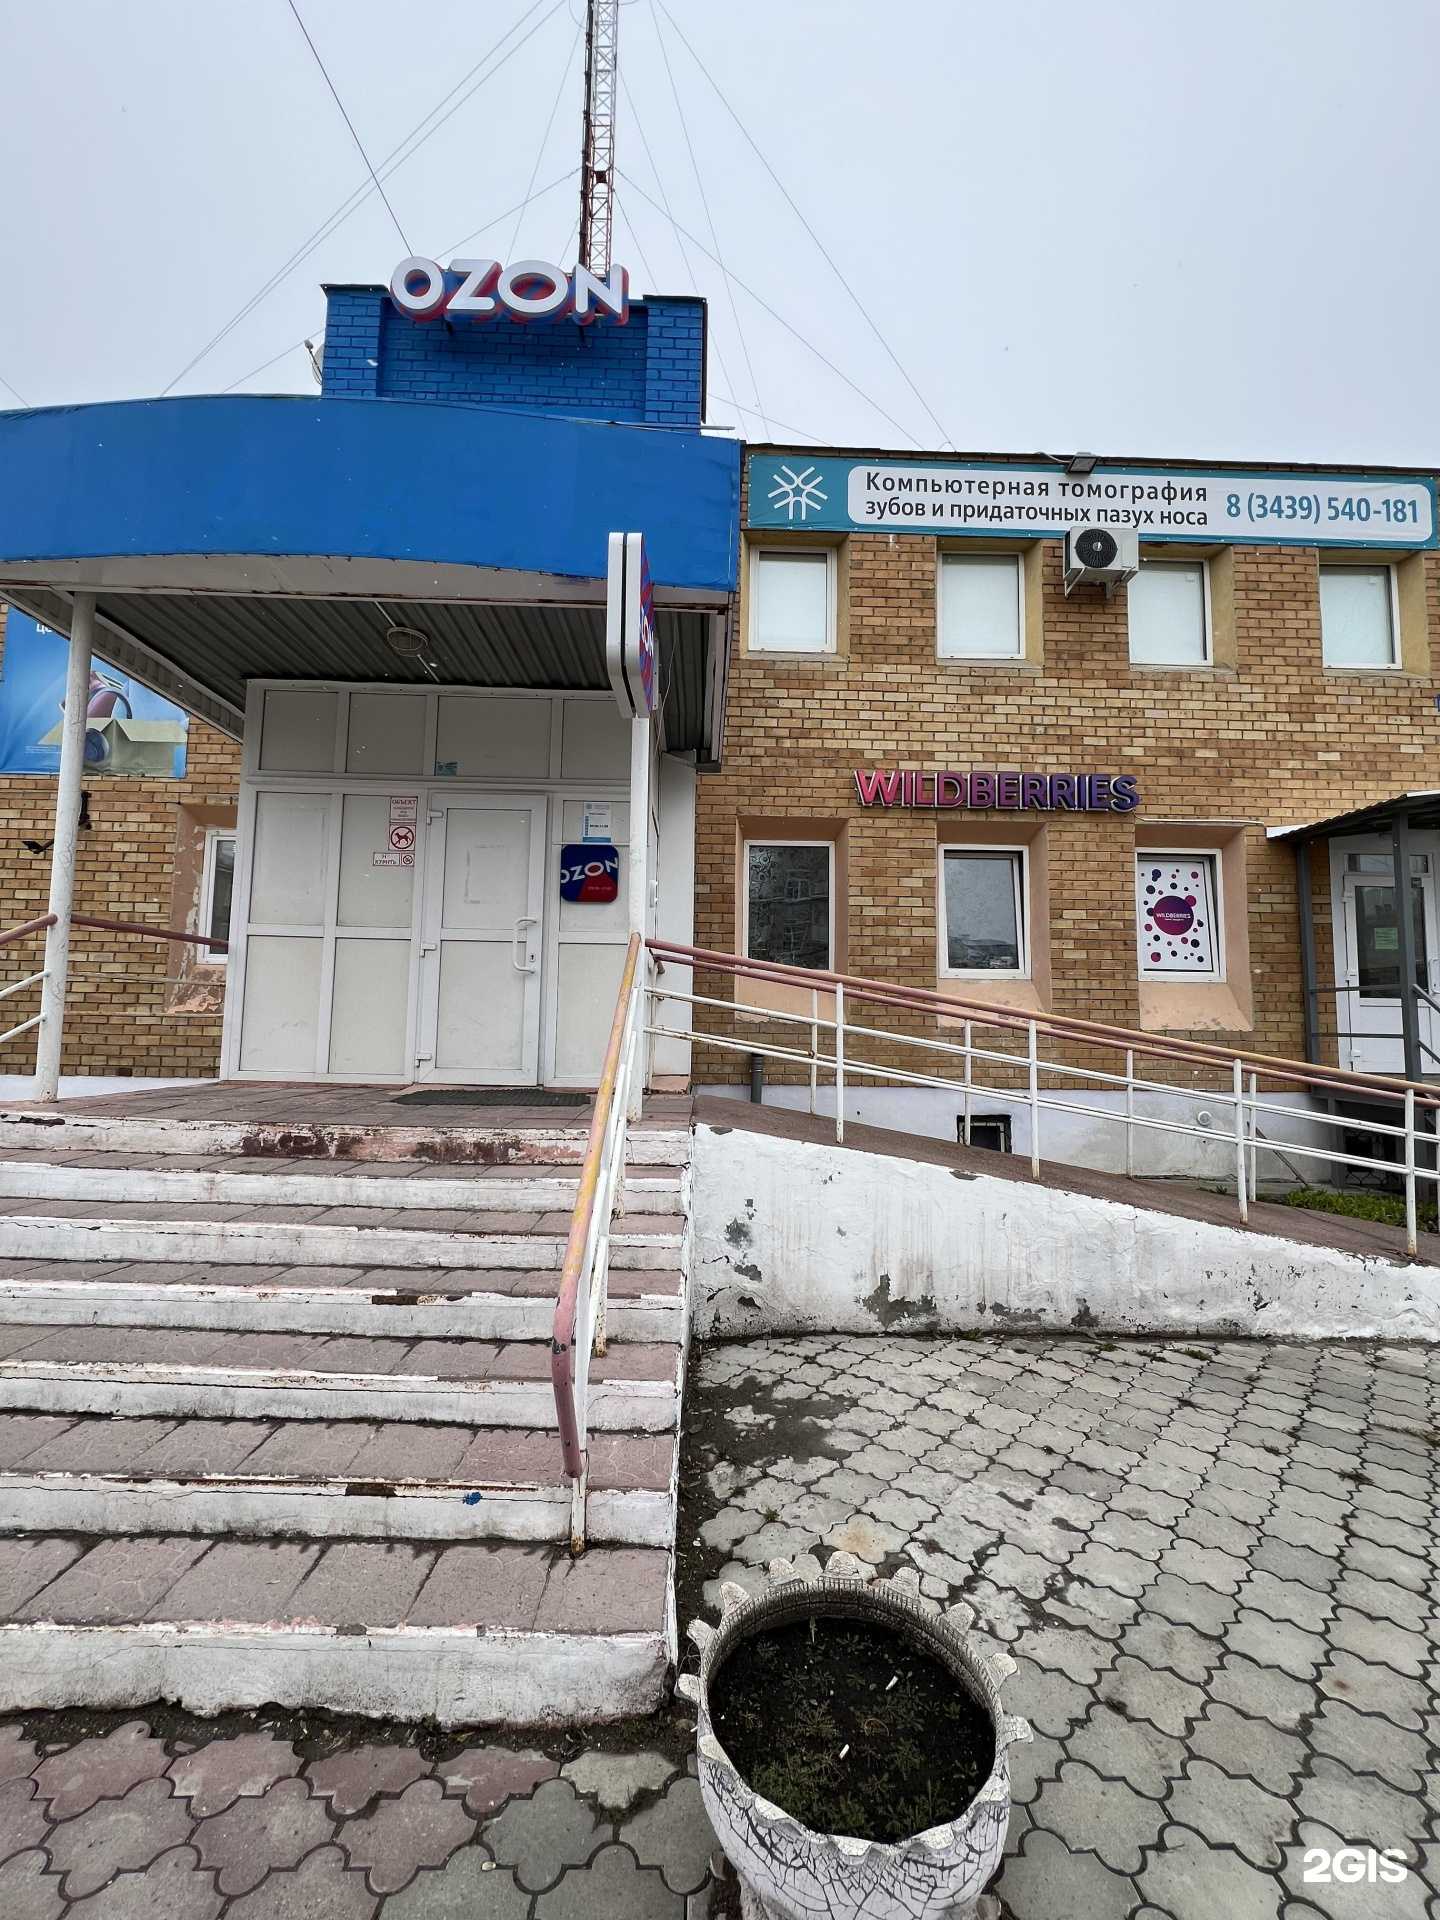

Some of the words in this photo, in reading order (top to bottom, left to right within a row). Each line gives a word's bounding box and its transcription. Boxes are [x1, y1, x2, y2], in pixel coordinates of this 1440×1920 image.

[390, 256, 628, 323] OZON
[865, 471, 1050, 500] Компьютерная
[1058, 480, 1208, 506] томография
[865, 496, 926, 520] зубов
[931, 503, 944, 517] и
[950, 503, 1091, 523] придаточных
[1097, 508, 1154, 529] пазух
[1160, 510, 1208, 526] носа
[1225, 493, 1241, 518] 8
[1246, 492, 1321, 525] (3439)
[1327, 496, 1419, 523] 540-181
[853, 769, 1141, 813] WILDBERRIES
